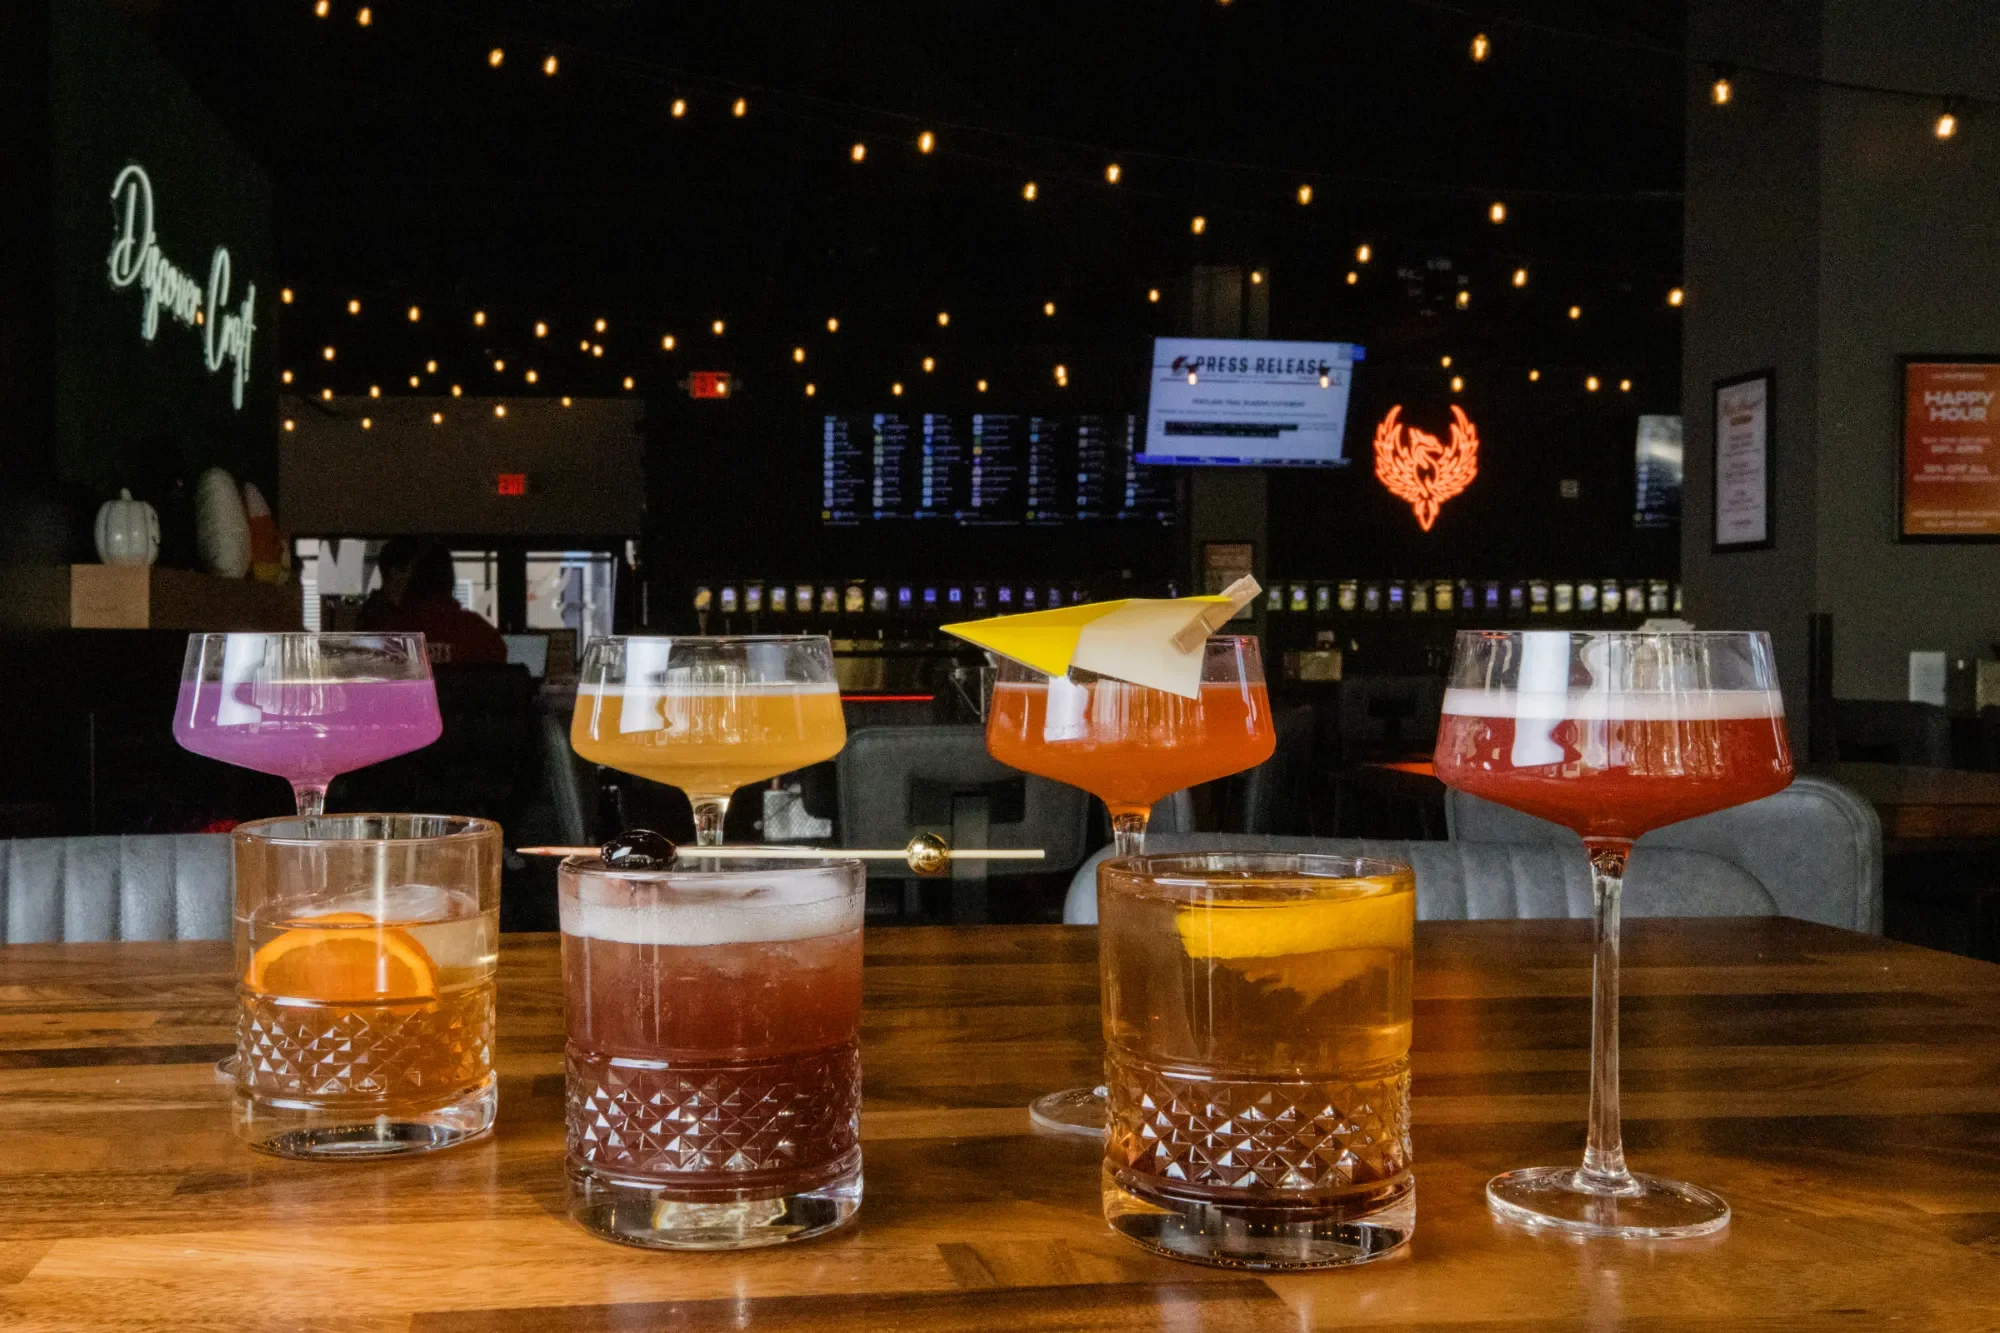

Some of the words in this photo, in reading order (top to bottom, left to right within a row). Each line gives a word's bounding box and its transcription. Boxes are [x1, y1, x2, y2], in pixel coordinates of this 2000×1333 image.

[1195, 355, 1248, 373] PRESS
[1924, 391, 1995, 405] HAPPY
[1930, 406, 1987, 421] HOUR
